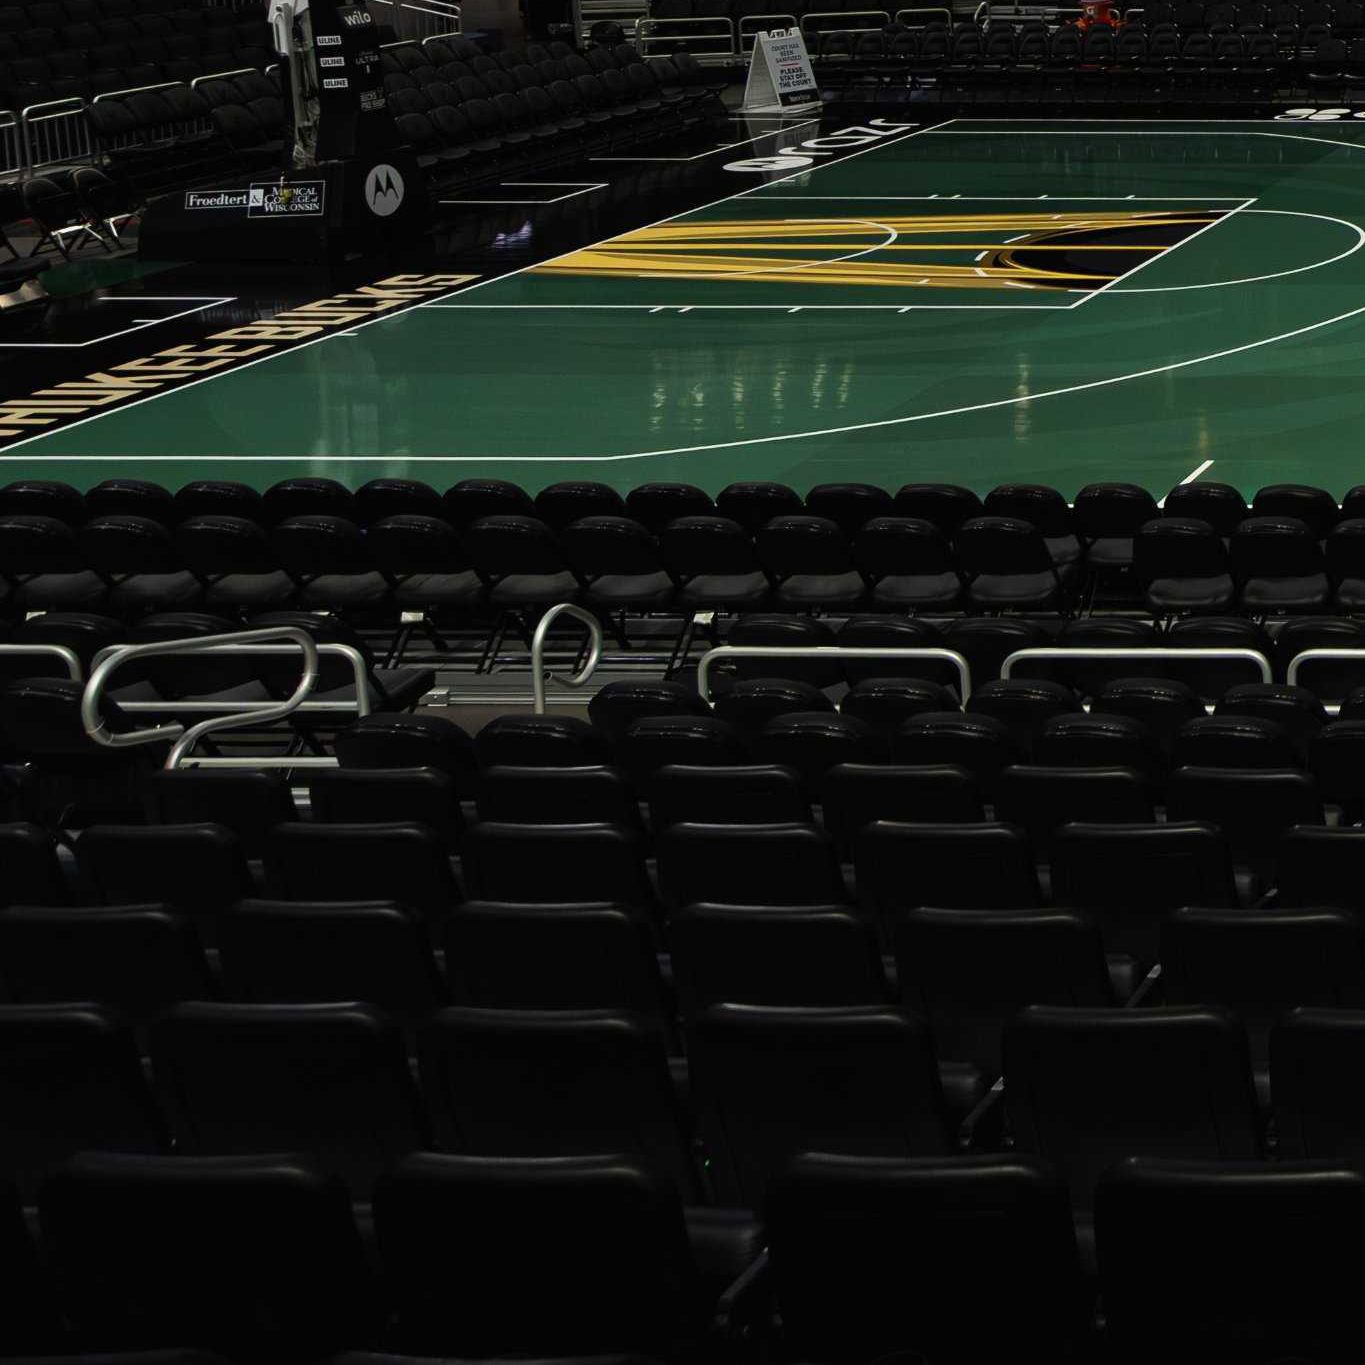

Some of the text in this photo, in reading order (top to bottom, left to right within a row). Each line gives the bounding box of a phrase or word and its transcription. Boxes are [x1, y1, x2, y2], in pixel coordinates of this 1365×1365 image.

[344, 10, 372, 26] wilo
[189, 194, 248, 207] Froedtert
[264, 202, 321, 213] WISCONSIN
[206, 274, 484, 340] BUCKS
